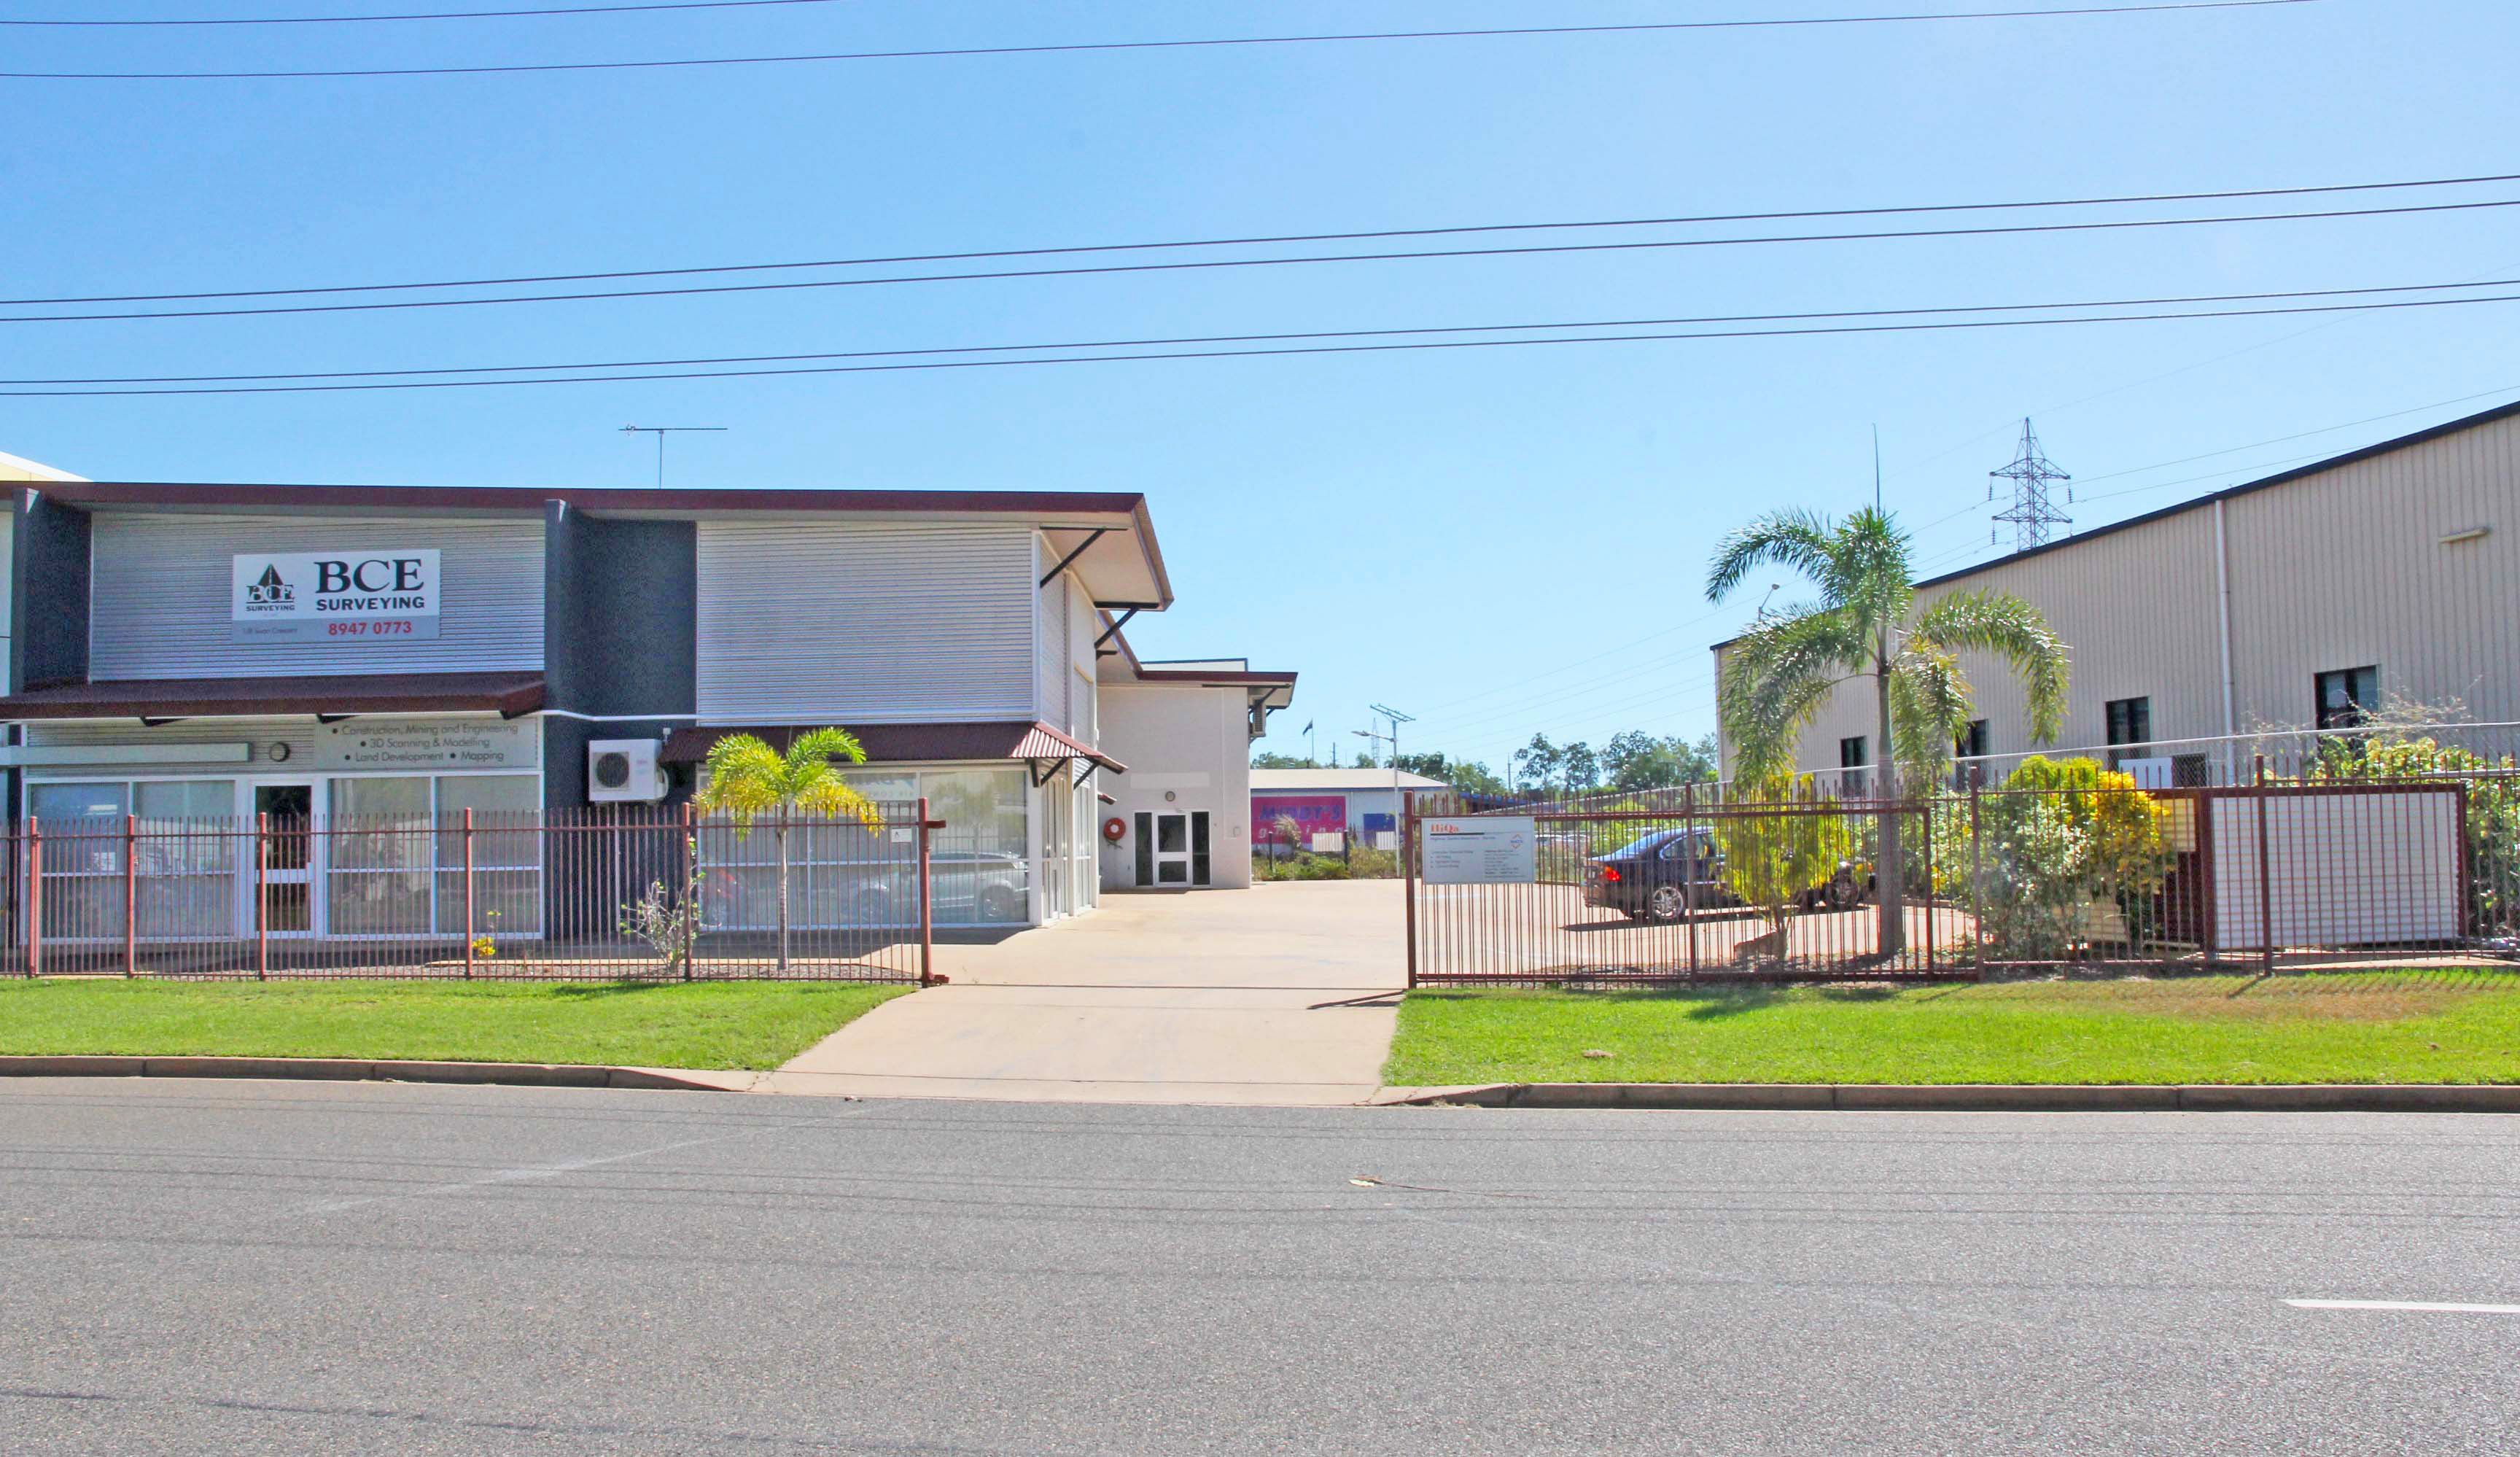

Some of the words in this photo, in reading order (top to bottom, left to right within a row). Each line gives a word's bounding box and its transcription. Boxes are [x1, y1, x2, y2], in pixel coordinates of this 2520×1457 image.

[314, 559, 424, 594] BCE
[316, 597, 425, 611] SURVEYING
[328, 622, 367, 636] 8947
[373, 621, 412, 634] 0773
[406, 724, 438, 736] Mining
[441, 723, 459, 733] and
[462, 723, 518, 735] Engineering
[370, 739, 384, 747] 3D
[387, 738, 430, 749] Scanning
[432, 737, 441, 747] &
[443, 737, 490, 748] Modelling
[355, 752, 378, 761] Land
[382, 750, 443, 762] Development
[461, 751, 504, 763] Mapping
